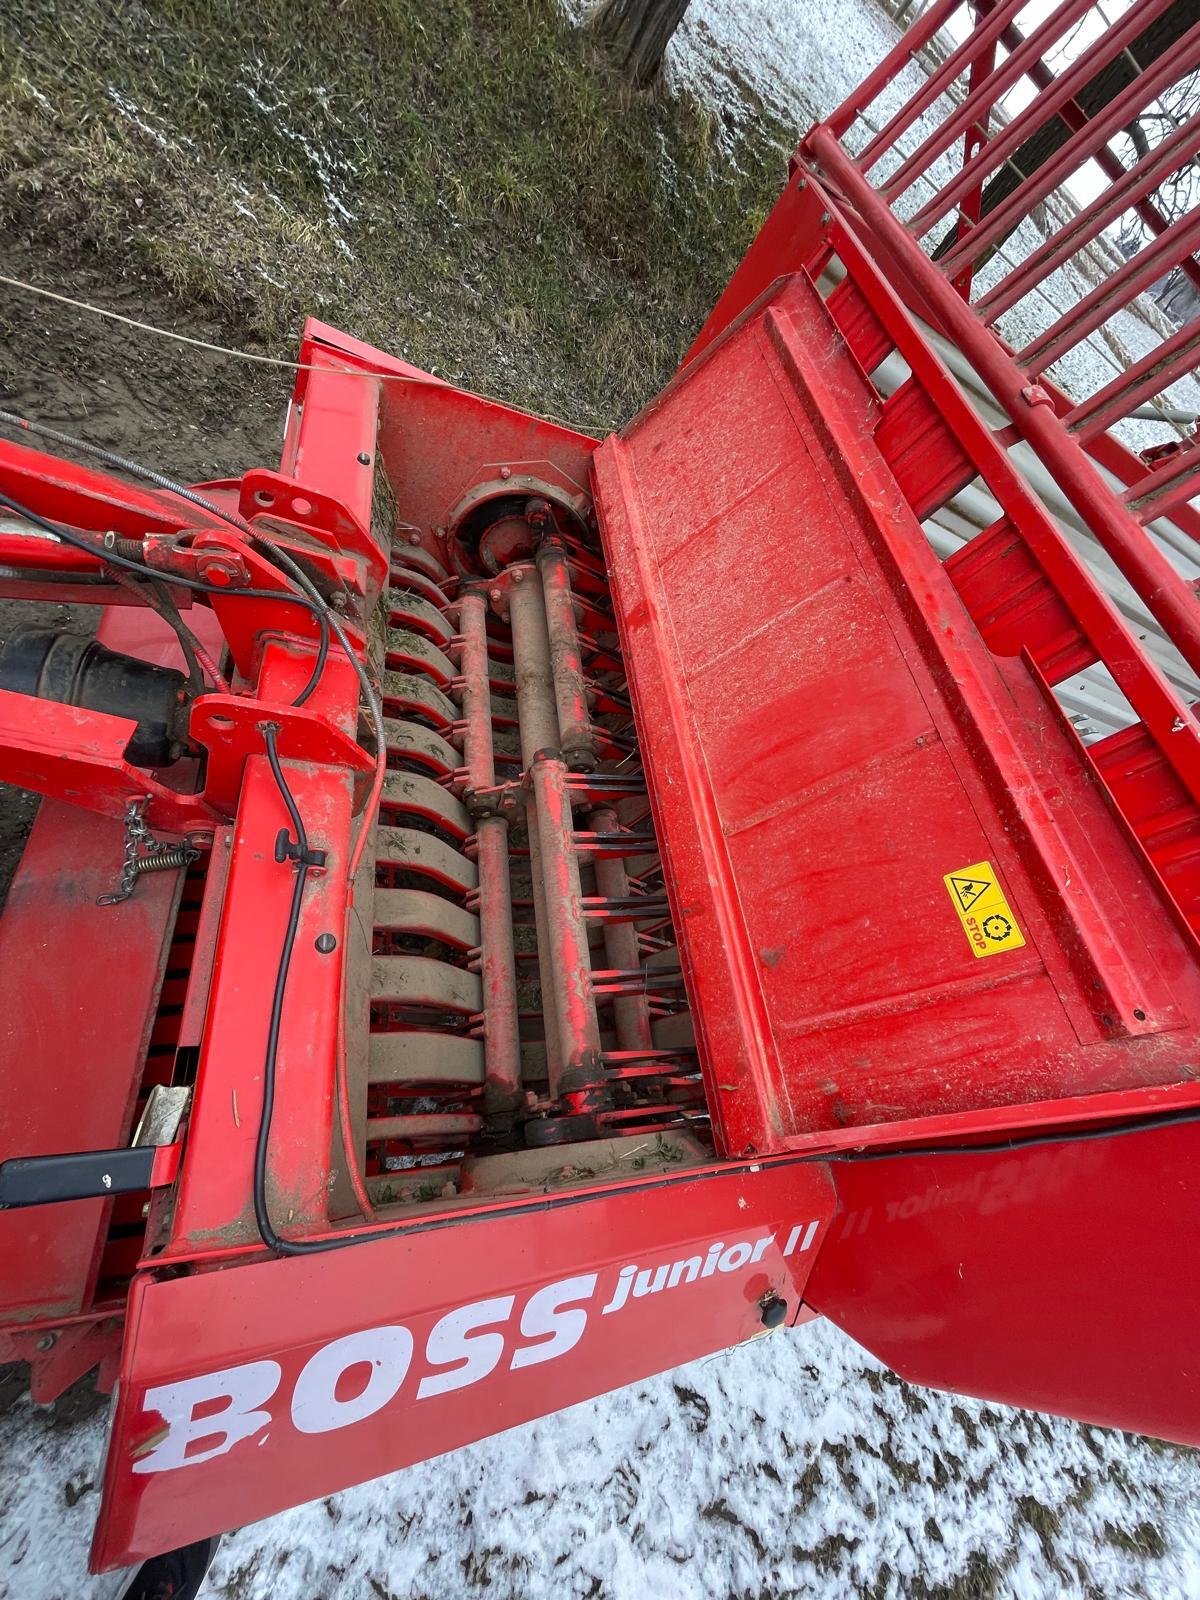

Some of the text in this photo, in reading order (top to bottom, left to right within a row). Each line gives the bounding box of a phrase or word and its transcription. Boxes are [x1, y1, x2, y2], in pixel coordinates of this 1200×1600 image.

[966, 917, 987, 950] STOP
[132, 1273, 597, 1473] BOSS
[602, 1234, 776, 1315] junior
